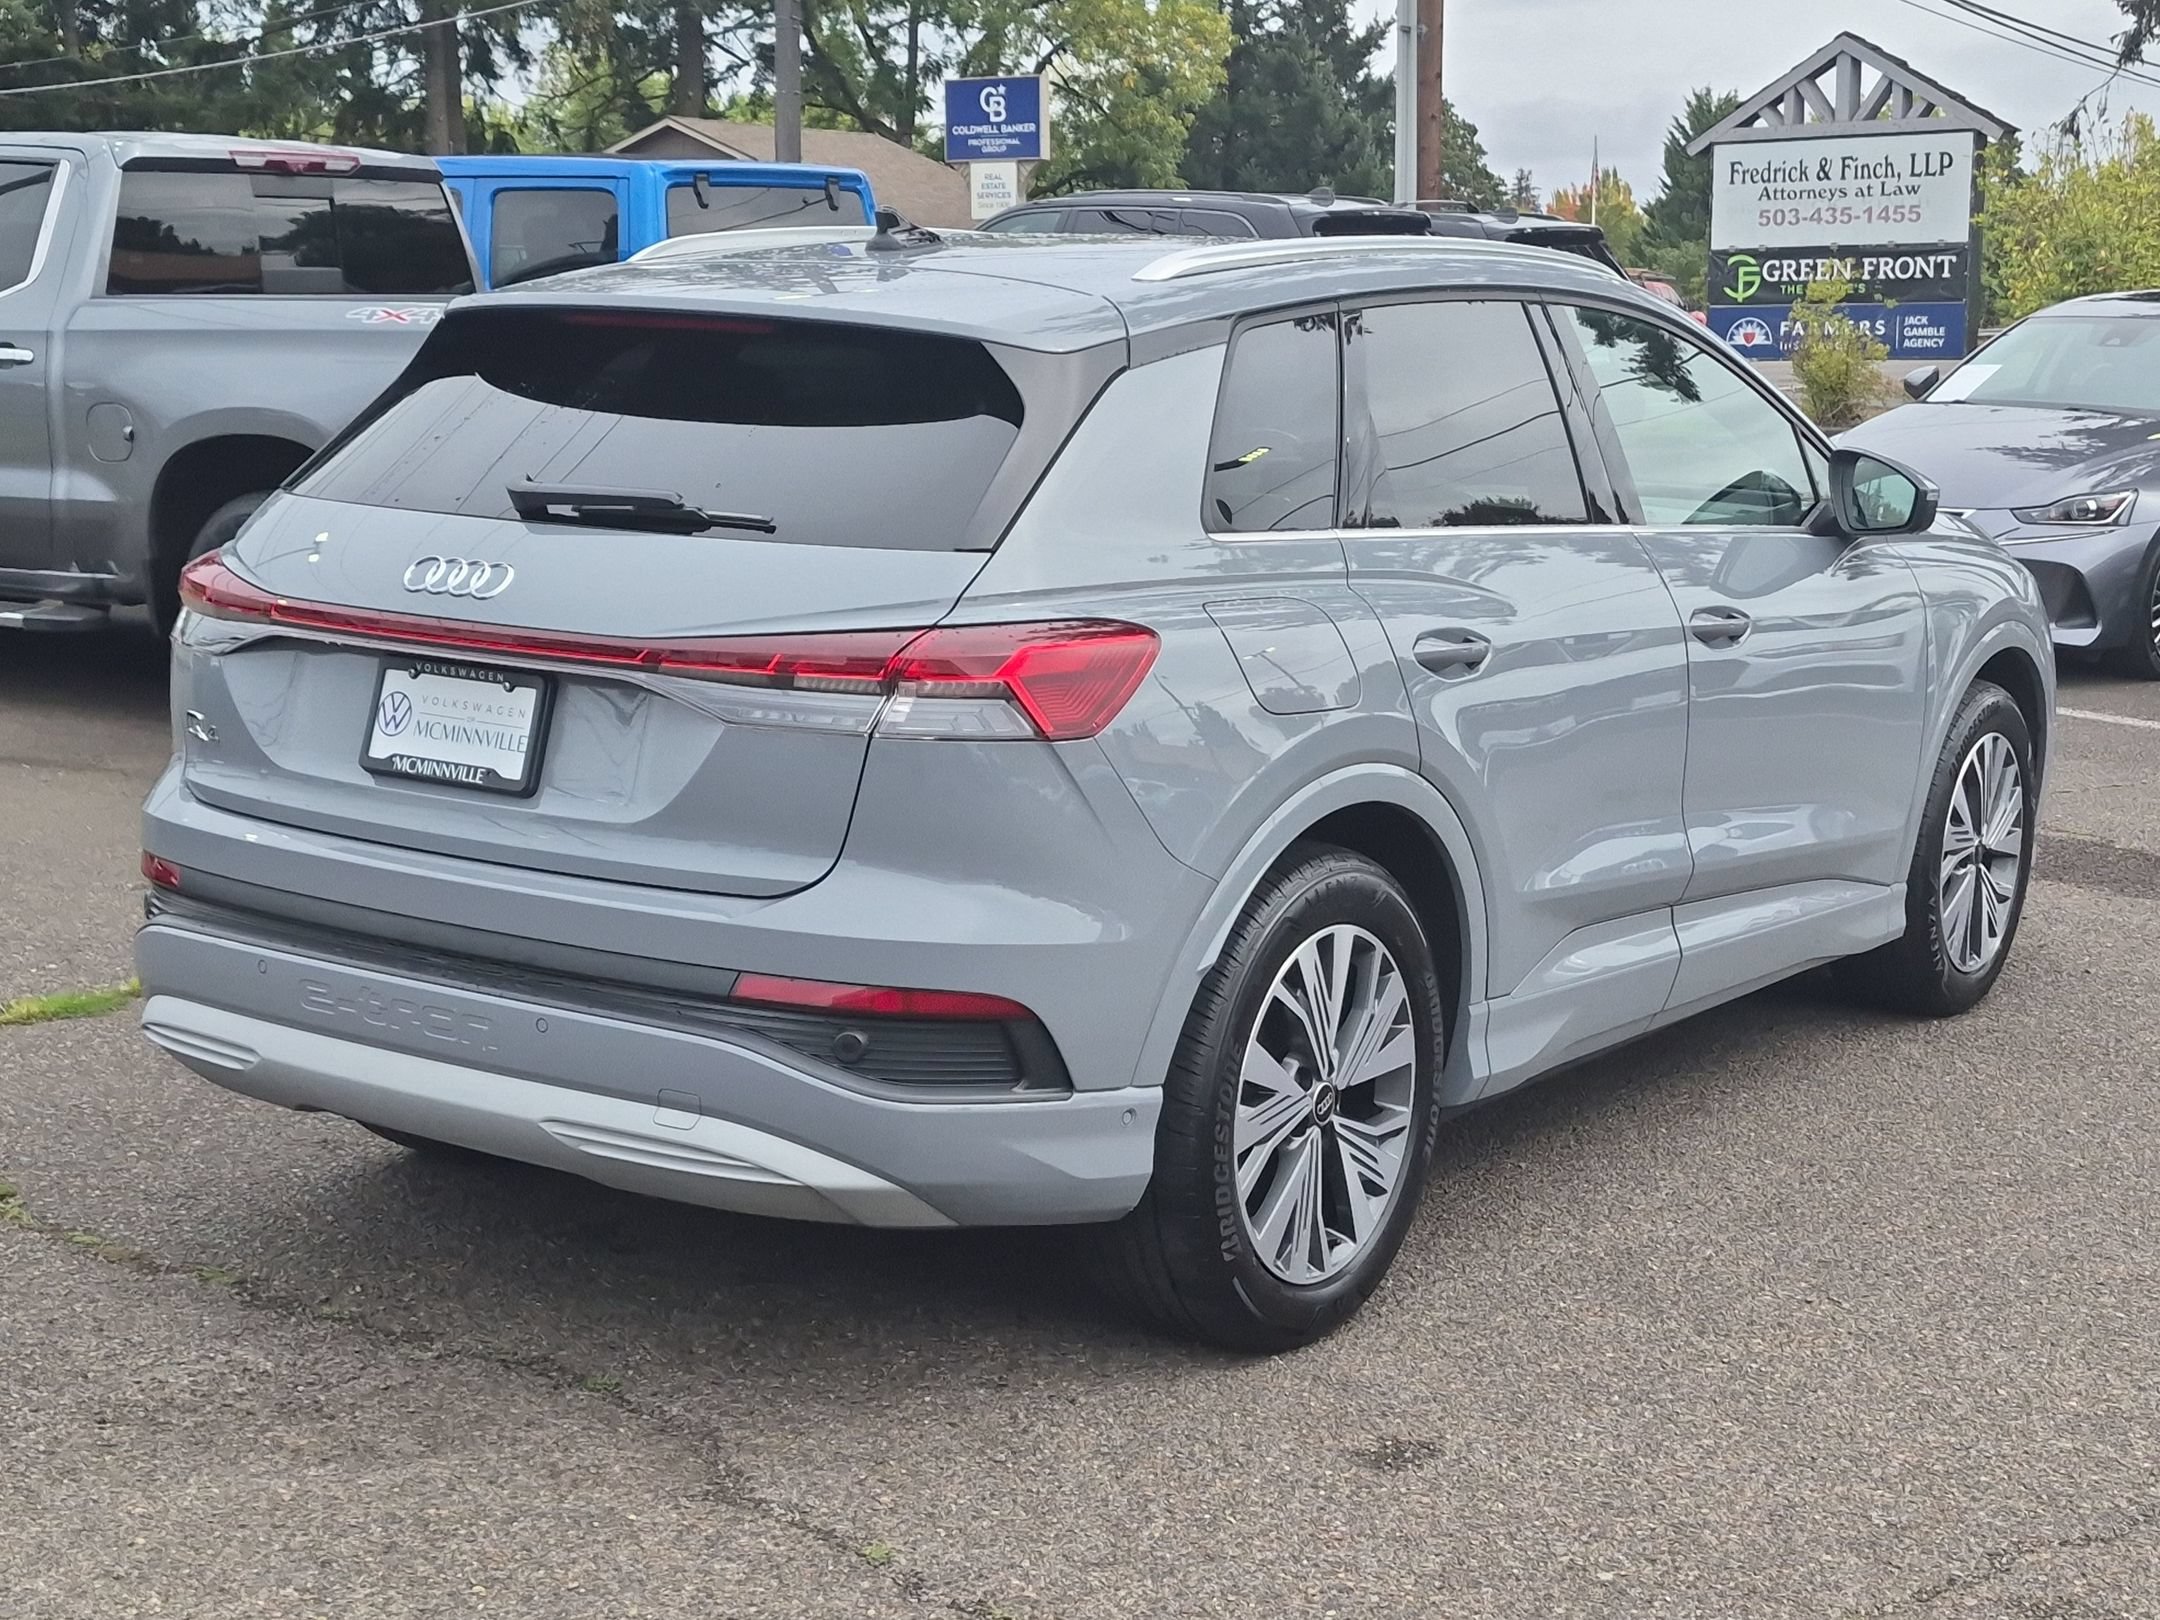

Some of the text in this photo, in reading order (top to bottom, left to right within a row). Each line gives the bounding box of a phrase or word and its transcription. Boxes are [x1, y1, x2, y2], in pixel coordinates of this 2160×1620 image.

[952, 123, 1036, 135] COLDWELL BANKER
[967, 137, 1021, 146] PROFESSIONAL
[981, 145, 1007, 153] GROUP
[984, 173, 1003, 181] REAL
[1729, 151, 1954, 185] Fredrick & Finch, LLP
[977, 190, 1011, 199] SERVICES
[981, 181, 1006, 190] ESTATE
[1758, 181, 1921, 203] Attorneys at Law
[1758, 204, 1922, 227] 503-435-1455
[1762, 256, 1957, 282] GREEN FRONT
[1780, 284, 1803, 295] THE
[1780, 319, 1886, 337] FAMRS
[1904, 315, 1928, 325] JACK
[1903, 326, 1945, 337] GAMBLE
[1903, 338, 1945, 348] AGENCY
[416, 662, 504, 682] VOLKSWAGEN
[421, 695, 526, 718] VOLKSWAGEN
[413, 719, 528, 753] MCMINNVILLE
[392, 755, 486, 784] MCMINNVILLE
[300, 979, 499, 1051] e-tron
[1213, 1040, 1244, 1263] BRIDGESTONE
